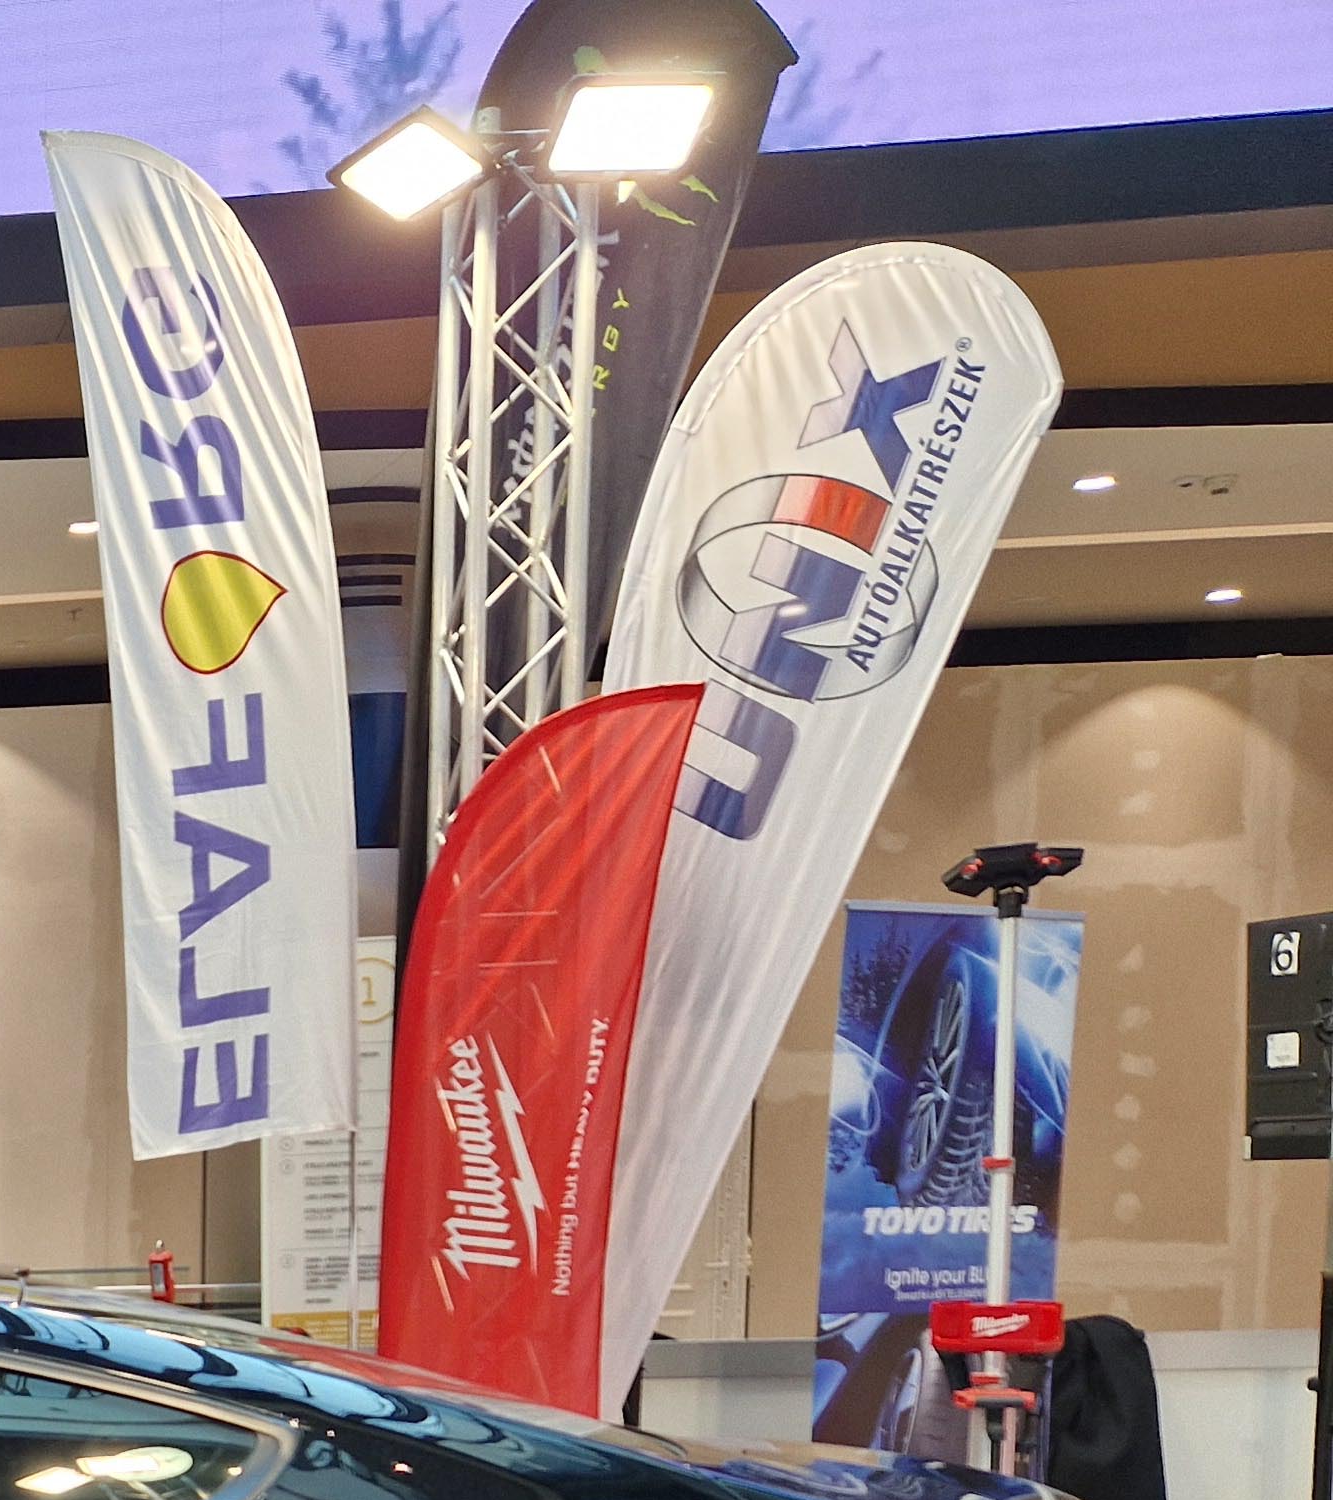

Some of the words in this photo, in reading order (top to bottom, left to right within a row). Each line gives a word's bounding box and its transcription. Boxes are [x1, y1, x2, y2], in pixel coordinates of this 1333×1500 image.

[1275, 932, 1294, 972] 6
[435, 1034, 522, 1281] Milwaukee
[559, 1174, 580, 1209] but
[863, 1205, 946, 1236] TOYO
[946, 1205, 1039, 1234] TIRS
[551, 1213, 580, 1297] Nothing
[885, 1266, 930, 1290] Ignite
[931, 1269, 966, 1288] your
